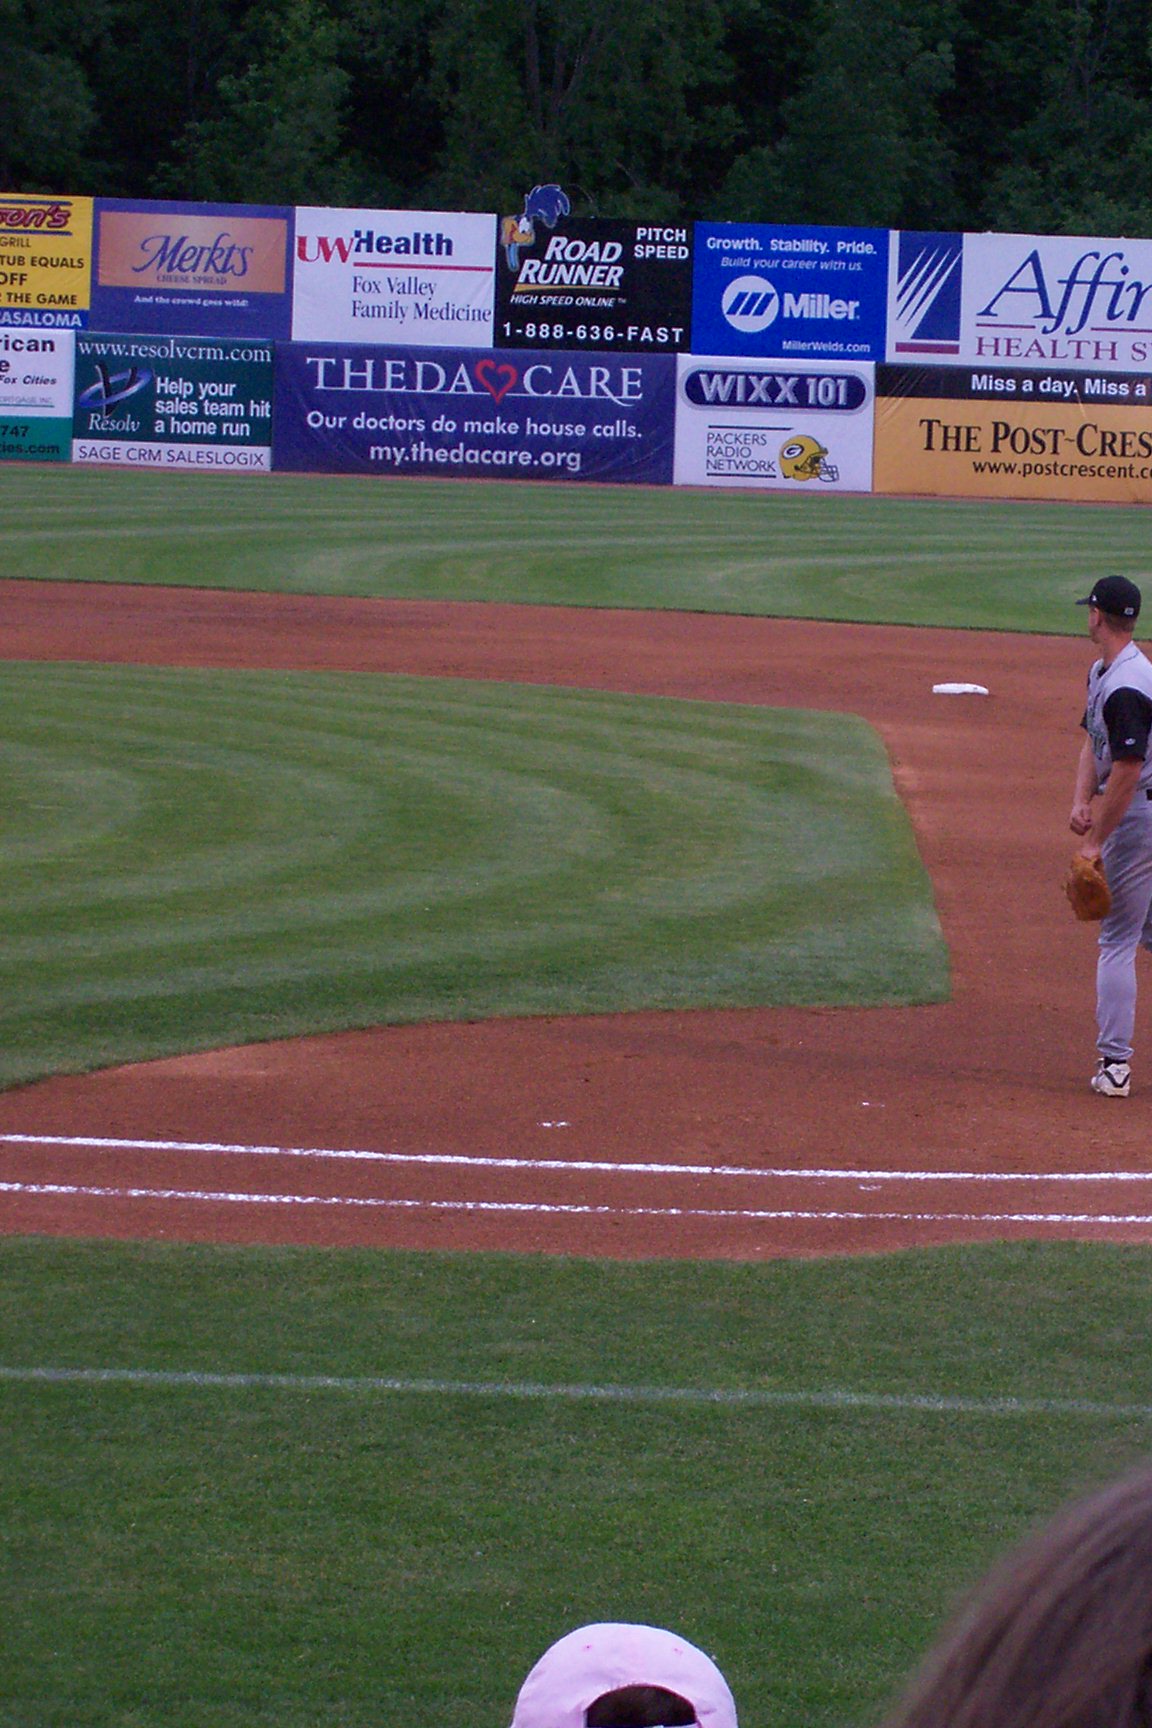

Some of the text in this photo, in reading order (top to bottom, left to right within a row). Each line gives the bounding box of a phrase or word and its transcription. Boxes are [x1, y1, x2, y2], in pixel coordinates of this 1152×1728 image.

[636, 227, 687, 243] PITCH
[296, 229, 453, 263] UW Health
[544, 235, 623, 264] ROAD
[633, 244, 689, 260] SPEED
[706, 236, 878, 256] Growth. Stability. Pride.
[31, 256, 85, 269] EQUALS
[517, 259, 624, 287] RUNNER
[720, 256, 750, 267] Build
[752, 259, 779, 270] your
[781, 259, 817, 270] career
[819, 260, 846, 270] with
[352, 275, 437, 300] Fox Valley
[6, 292, 78, 305] THE GAME
[510, 294, 616, 308] HIGH SPEED ONLINE
[782, 292, 861, 320] Miller
[351, 300, 492, 325] Family Medicine
[502, 321, 684, 343] 1-888-636-FAST
[0, 334, 55, 352] ican
[78, 339, 272, 363] www.resolvcrm.com
[782, 340, 871, 353] MillerWelds.com
[975, 336, 1118, 362] HEALTH
[22, 375, 57, 385] Cities
[156, 376, 237, 400] Help your
[306, 356, 644, 408] THEDA CARE
[699, 373, 848, 406] WIXX 101
[971, 373, 1016, 392] Miss
[1023, 379, 1033, 392] a
[1039, 376, 1078, 397] day.
[1084, 378, 1130, 397] Miss
[1135, 384, 1146, 397] a
[155, 399, 271, 418] sales team hit
[88, 413, 141, 433] Resolv
[154, 418, 251, 437] a home run
[306, 410, 643, 439] Our doctors do make house calls.
[706, 432, 768, 446] PACKERS
[919, 418, 982, 453] THE
[79, 445, 265, 466] SAGE CRM SALESLOGIX
[369, 442, 582, 472] my.thedacare.org
[706, 445, 752, 458] RADIO
[706, 459, 777, 472] NETWORK
